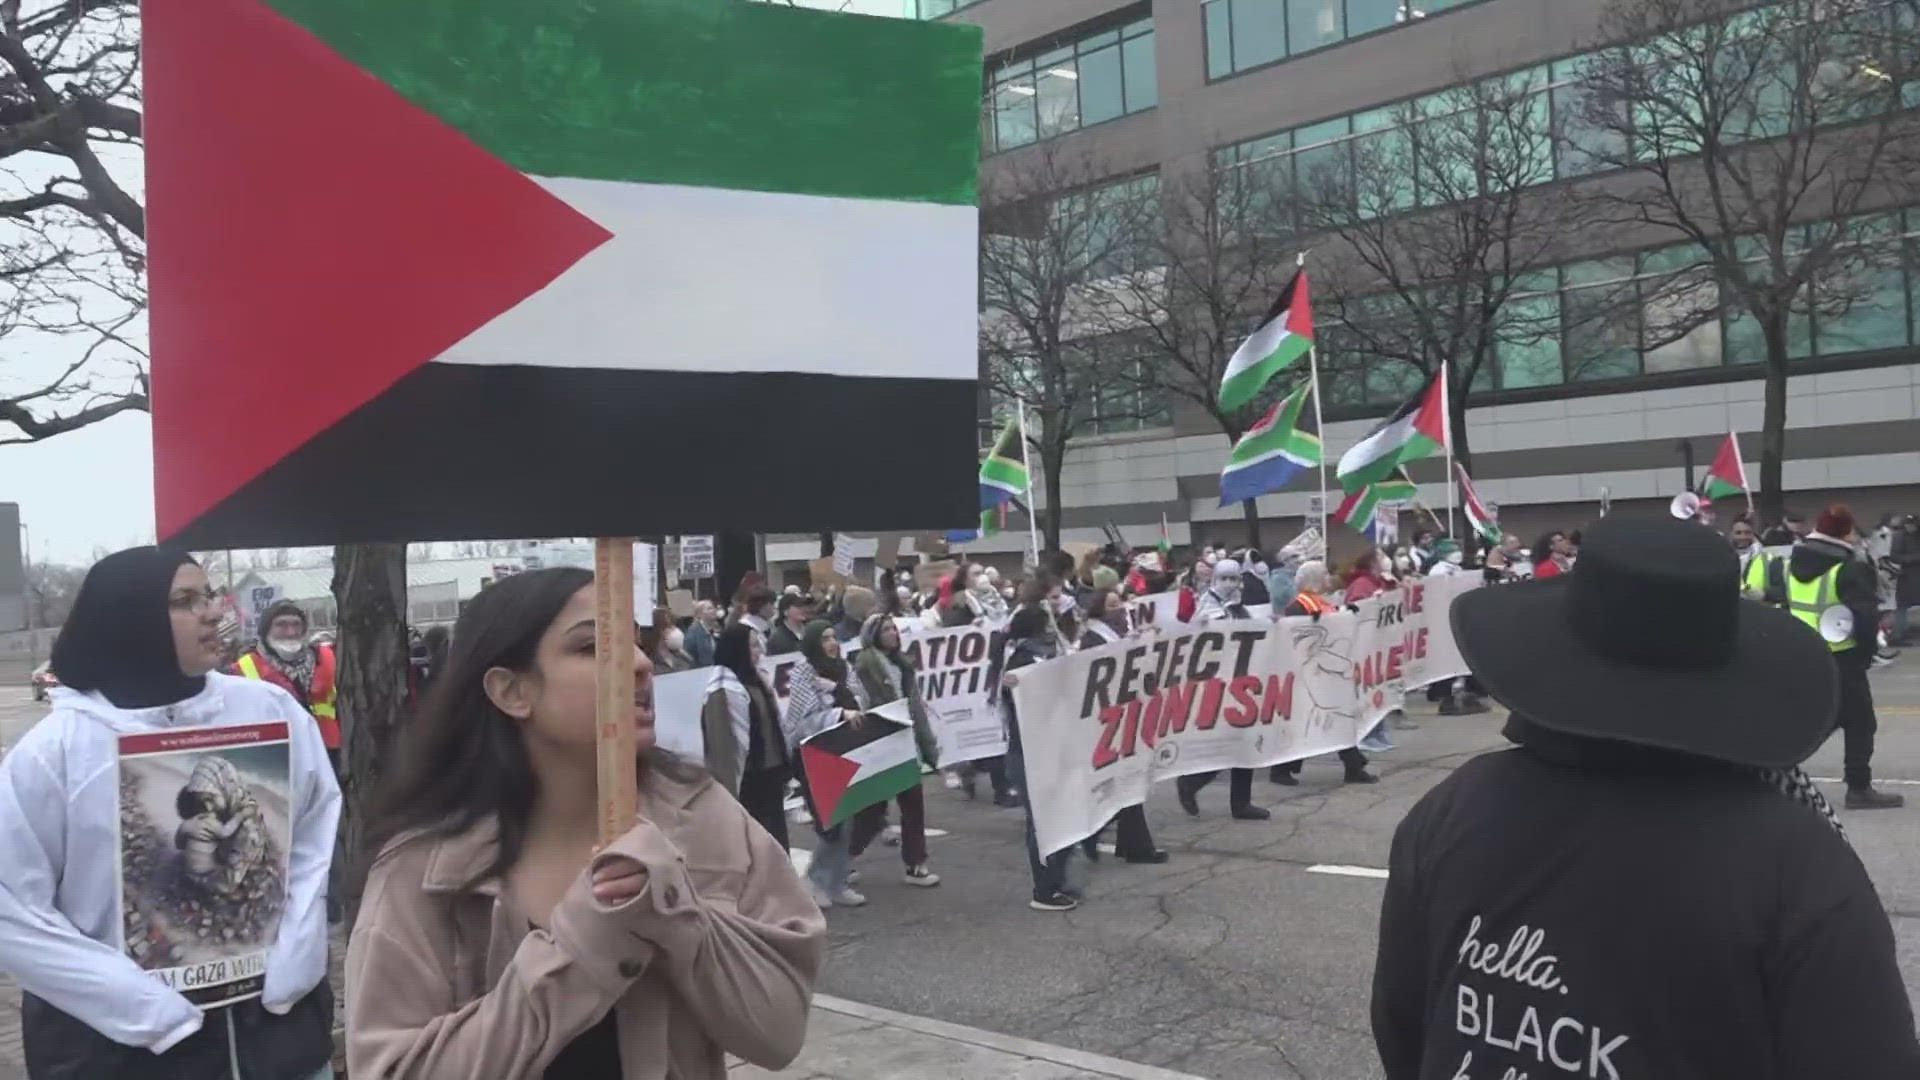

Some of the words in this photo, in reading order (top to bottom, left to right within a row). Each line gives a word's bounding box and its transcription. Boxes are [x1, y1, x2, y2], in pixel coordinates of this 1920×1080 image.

[1080, 630, 1267, 719] REJECT
[1092, 671, 1295, 770] ZIONISM
[184, 963, 226, 985] GAZA
[1458, 915, 1568, 994] hella.
[1457, 984, 1629, 1080] BLACK
